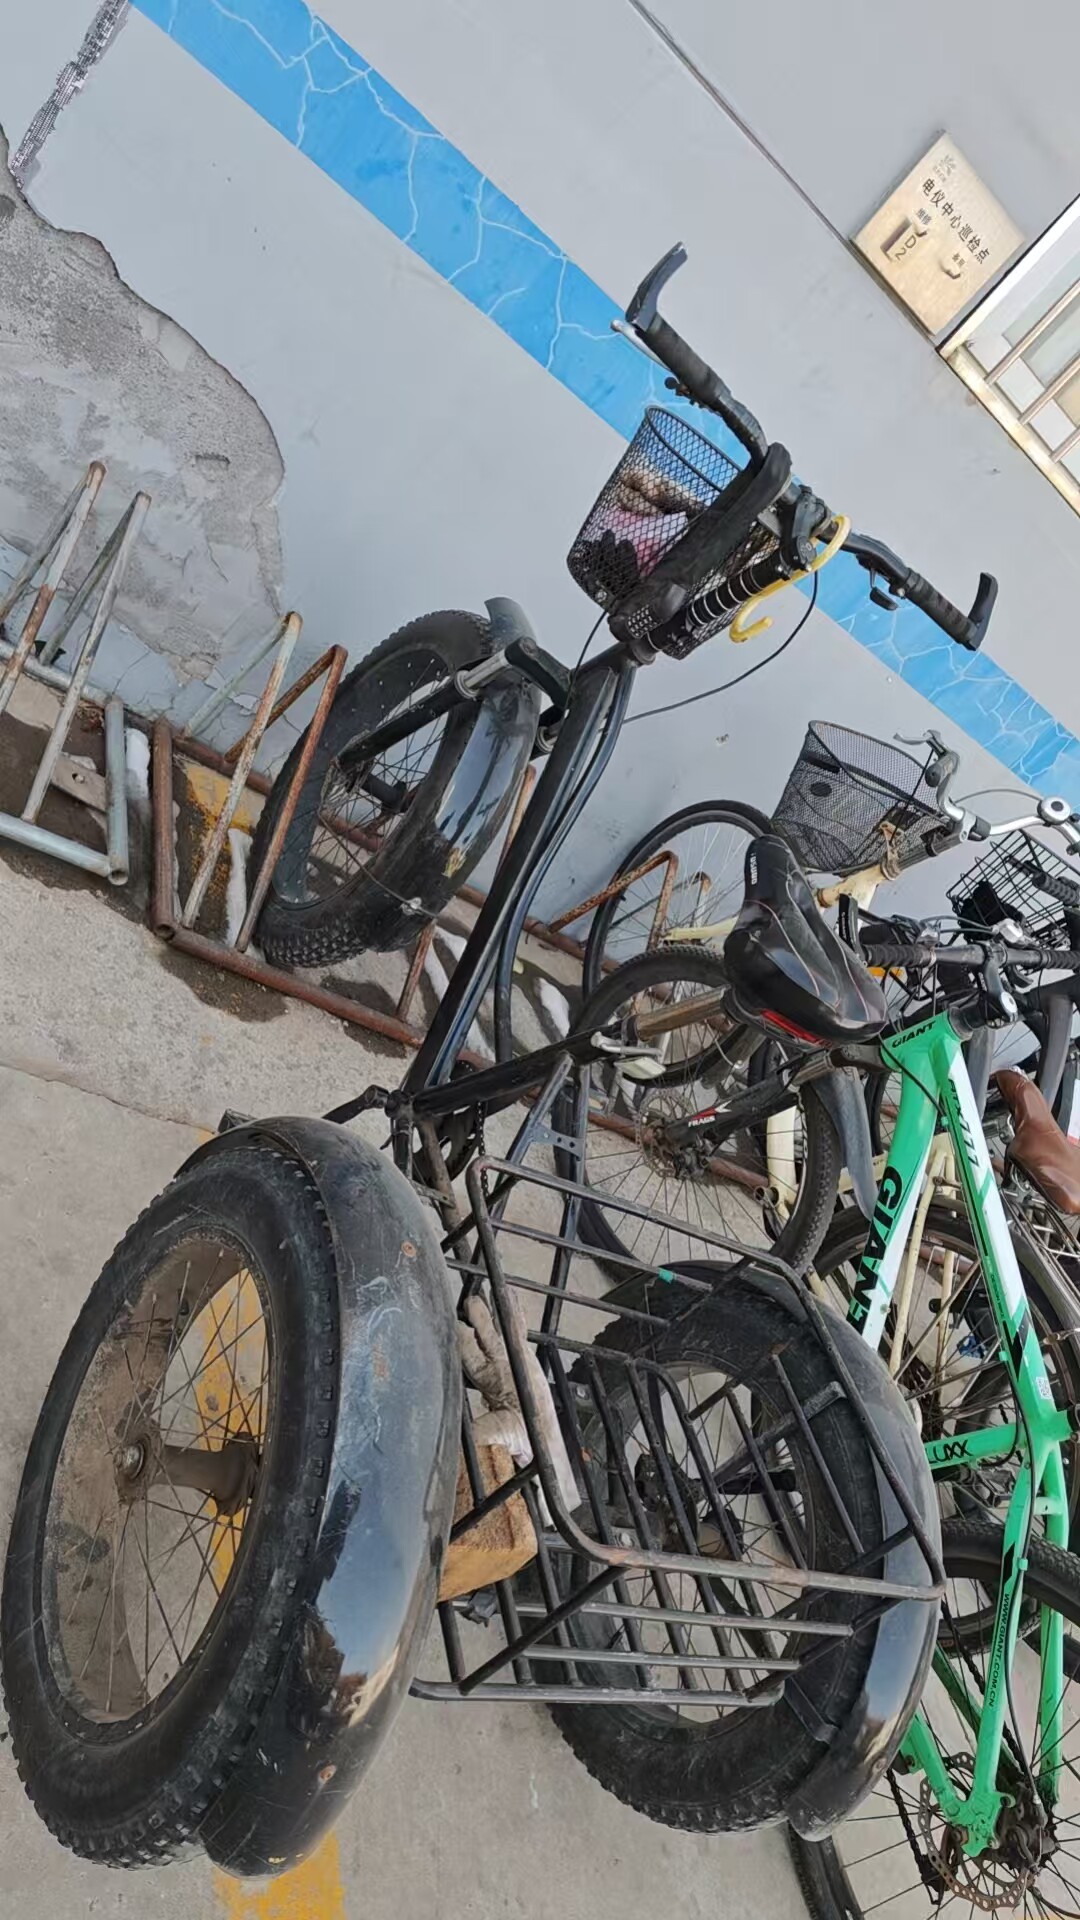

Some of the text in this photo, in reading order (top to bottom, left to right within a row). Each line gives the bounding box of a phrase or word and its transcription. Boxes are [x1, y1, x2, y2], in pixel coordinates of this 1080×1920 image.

[922, 178, 990, 264] 电仪中心巡检点
[892, 1020, 936, 1048] GIANT
[846, 1166, 902, 1336] GIANT
[988, 1593, 1010, 1708] WWW.GIANT.COM.CN
